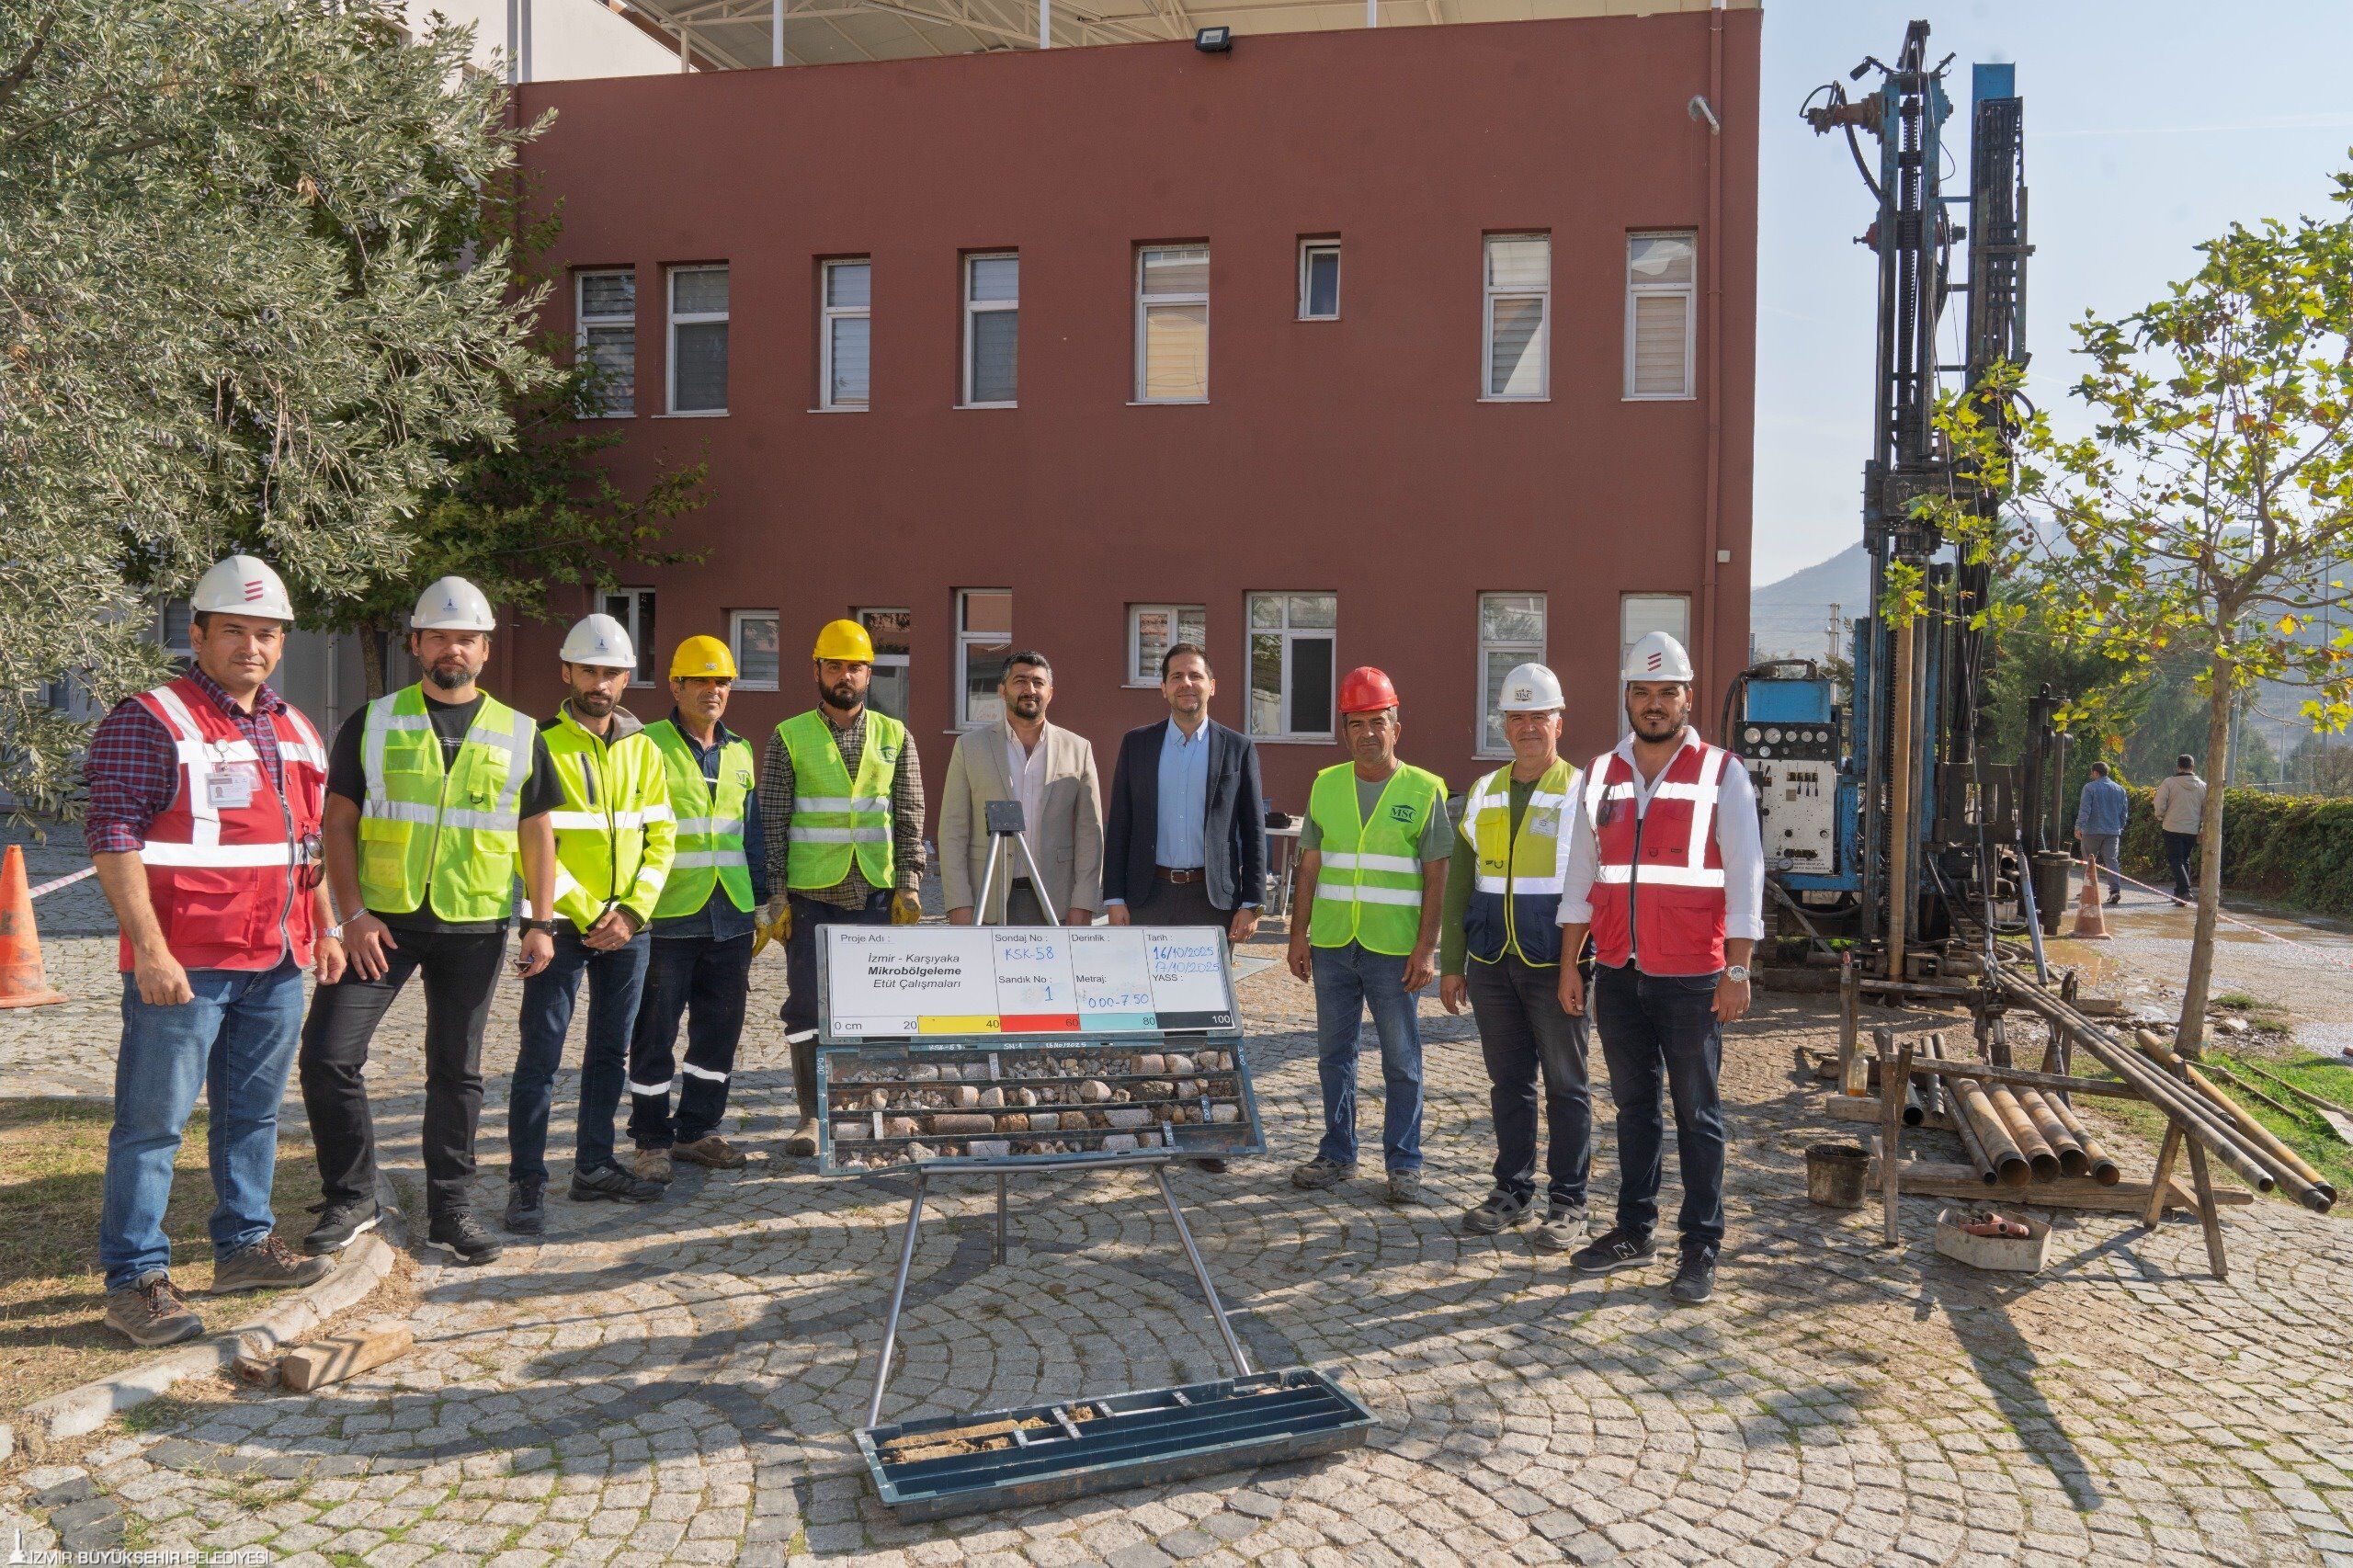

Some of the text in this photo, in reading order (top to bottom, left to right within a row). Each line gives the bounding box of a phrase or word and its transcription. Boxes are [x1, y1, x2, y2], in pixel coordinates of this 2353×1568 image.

[1390, 807, 1416, 821] MSC
[840, 934, 866, 943] Proje
[868, 934, 885, 942] Adı
[995, 934, 1027, 943] Sondaj
[1029, 934, 1043, 942] No
[1071, 934, 1105, 942] Derinlik
[1148, 934, 1168, 942] Tarih
[868, 952, 895, 962] İzmir
[905, 953, 960, 965] Karşıyaka
[1005, 946, 1054, 960] KSK-58
[1153, 946, 1214, 960] 16/10/2025
[868, 966, 961, 977] Mikrobölgeleme
[873, 979, 961, 990] Etüt Çalışmaları
[998, 975, 1031, 983] Sandık
[1033, 975, 1047, 983] No
[1076, 975, 1107, 983] Metraj:
[1044, 986, 1053, 1002] 1
[835, 1015, 1231, 1030] 0 cm 20 40 60 80 100
